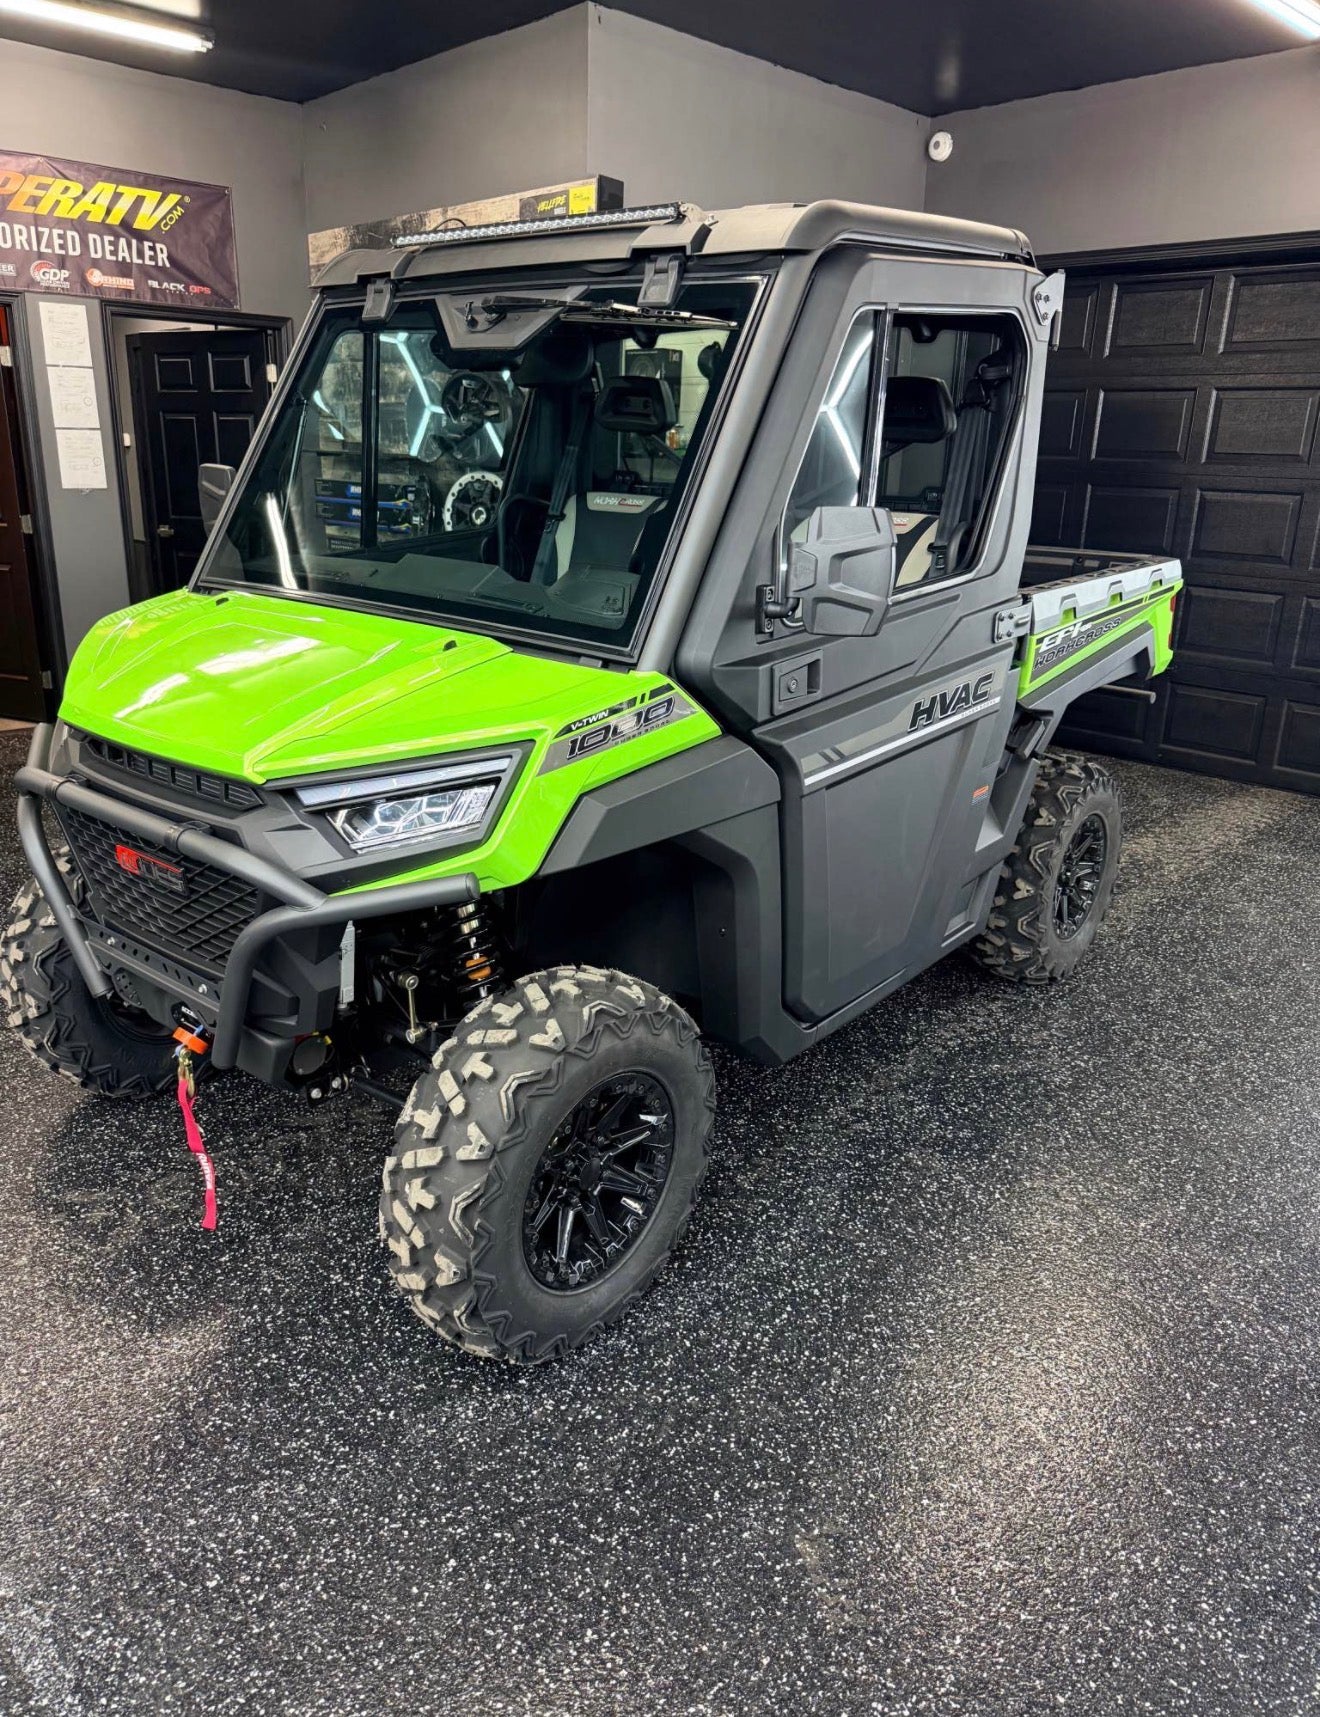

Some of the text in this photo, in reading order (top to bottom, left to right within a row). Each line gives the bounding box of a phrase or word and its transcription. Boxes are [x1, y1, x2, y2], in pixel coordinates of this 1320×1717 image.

[89, 232, 171, 268] DEALER
[39, 267, 70, 281] GDP
[147, 279, 185, 291] BLACK
[907, 670, 996, 733] HVAC
[566, 695, 676, 760] 1000
[570, 709, 609, 731] V-TWIN
